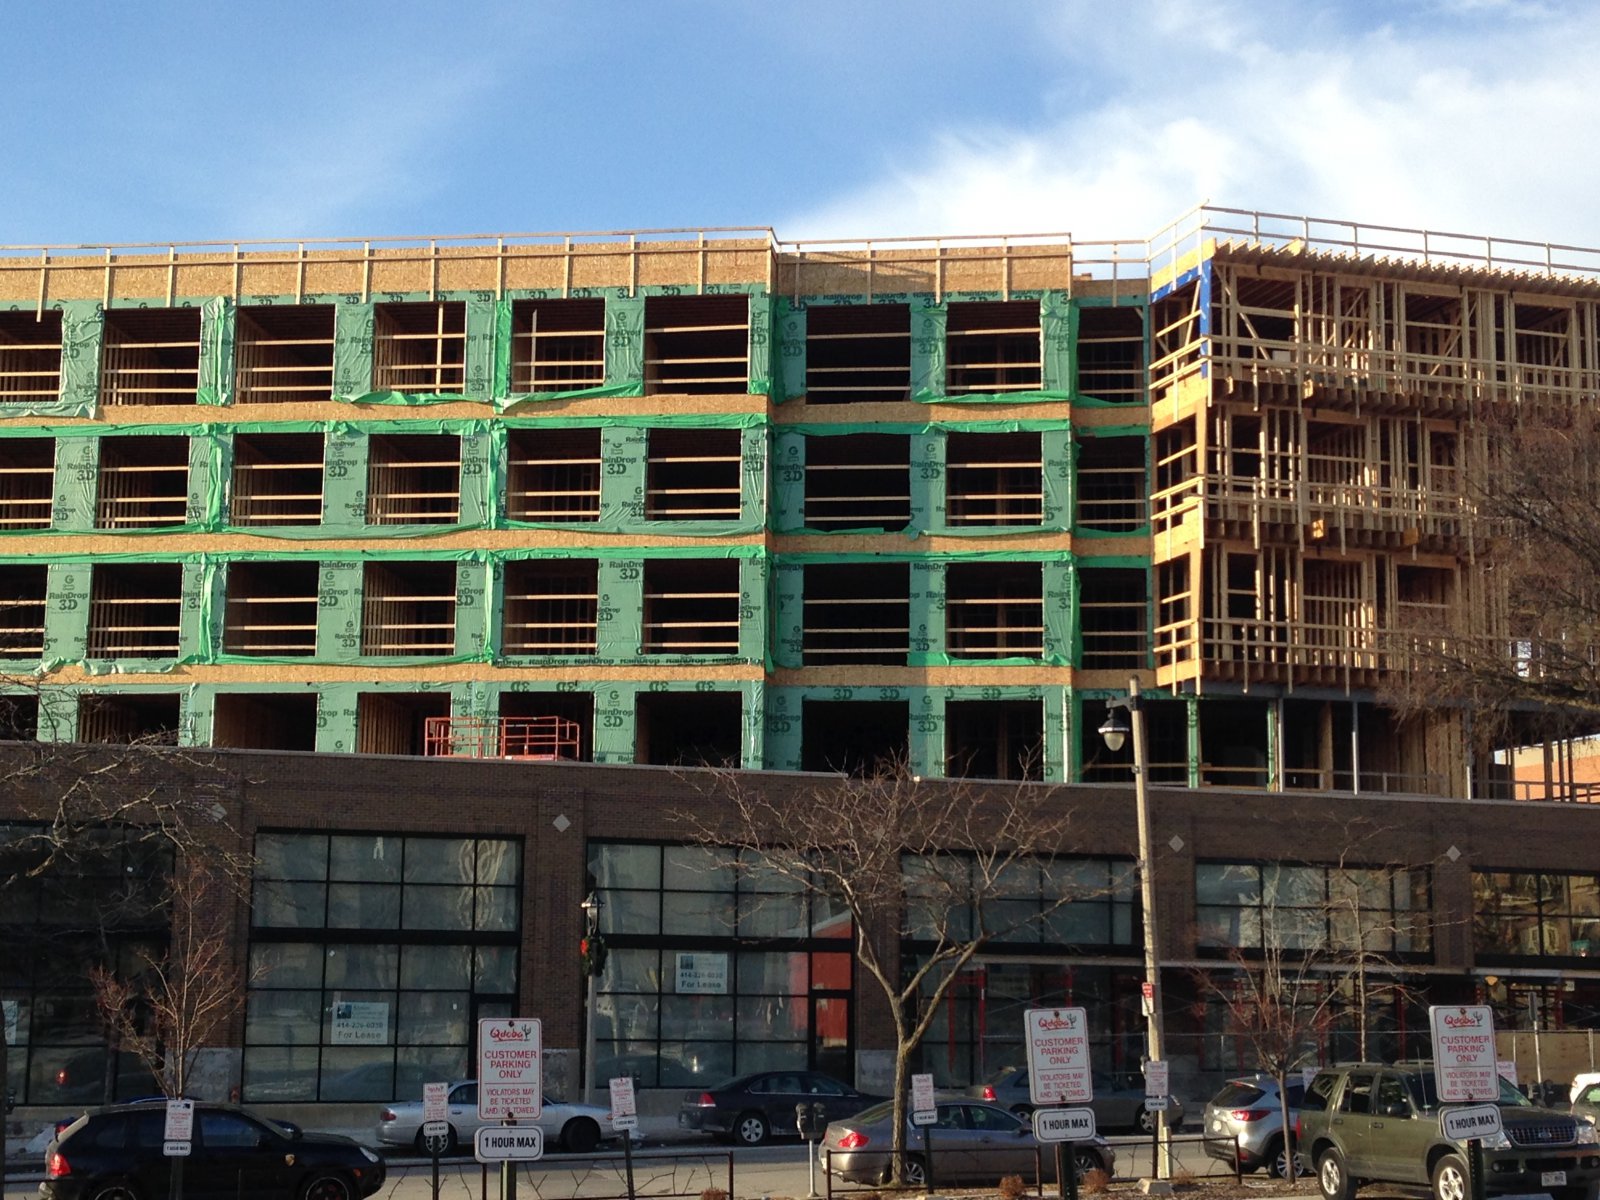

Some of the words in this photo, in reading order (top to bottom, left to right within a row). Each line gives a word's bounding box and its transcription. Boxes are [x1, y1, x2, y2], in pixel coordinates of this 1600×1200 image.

[328, 466, 348, 478] 3D
[464, 464, 482, 475] 3D
[606, 464, 626, 475] 3D
[920, 468, 940, 480] 3D
[76, 470, 96, 481] 3D
[784, 471, 803, 482] 3D
[325, 572, 335, 580] G
[461, 570, 470, 580] G
[620, 568, 640, 580] 3D
[65, 575, 74, 584] G
[59, 600, 78, 611] 3D
[319, 596, 338, 606] 3D
[457, 595, 474, 606] 3D
[342, 639, 356, 648] 3D
[610, 690, 619, 700] G
[834, 688, 853, 700] 3D
[880, 688, 900, 700] 3D
[604, 716, 624, 728] 3D
[770, 721, 791, 733] 3D
[918, 720, 938, 732] 3D
[682, 980, 694, 988] For
[1035, 1037, 1083, 1046] CUSTOMER
[1441, 1036, 1490, 1044] CUSTOMER
[1041, 1046, 1078, 1056] PARKING
[1448, 1045, 1485, 1053] PARKING
[484, 1050, 536, 1059] CUSTOMER
[1456, 1054, 1478, 1062] ONLY
[490, 1060, 531, 1068] PARKING
[1050, 1056, 1071, 1065] ONLY
[499, 1070, 522, 1078] ONLY
[486, 1088, 520, 1096] VIOLATORS
[1049, 1120, 1070, 1130] HOUR
[1072, 1118, 1089, 1128] MAX
[1456, 1118, 1476, 1129] HOUR
[1479, 1115, 1495, 1125] MAX
[492, 1137, 514, 1148] HOUR
[516, 1137, 536, 1148] MAX
